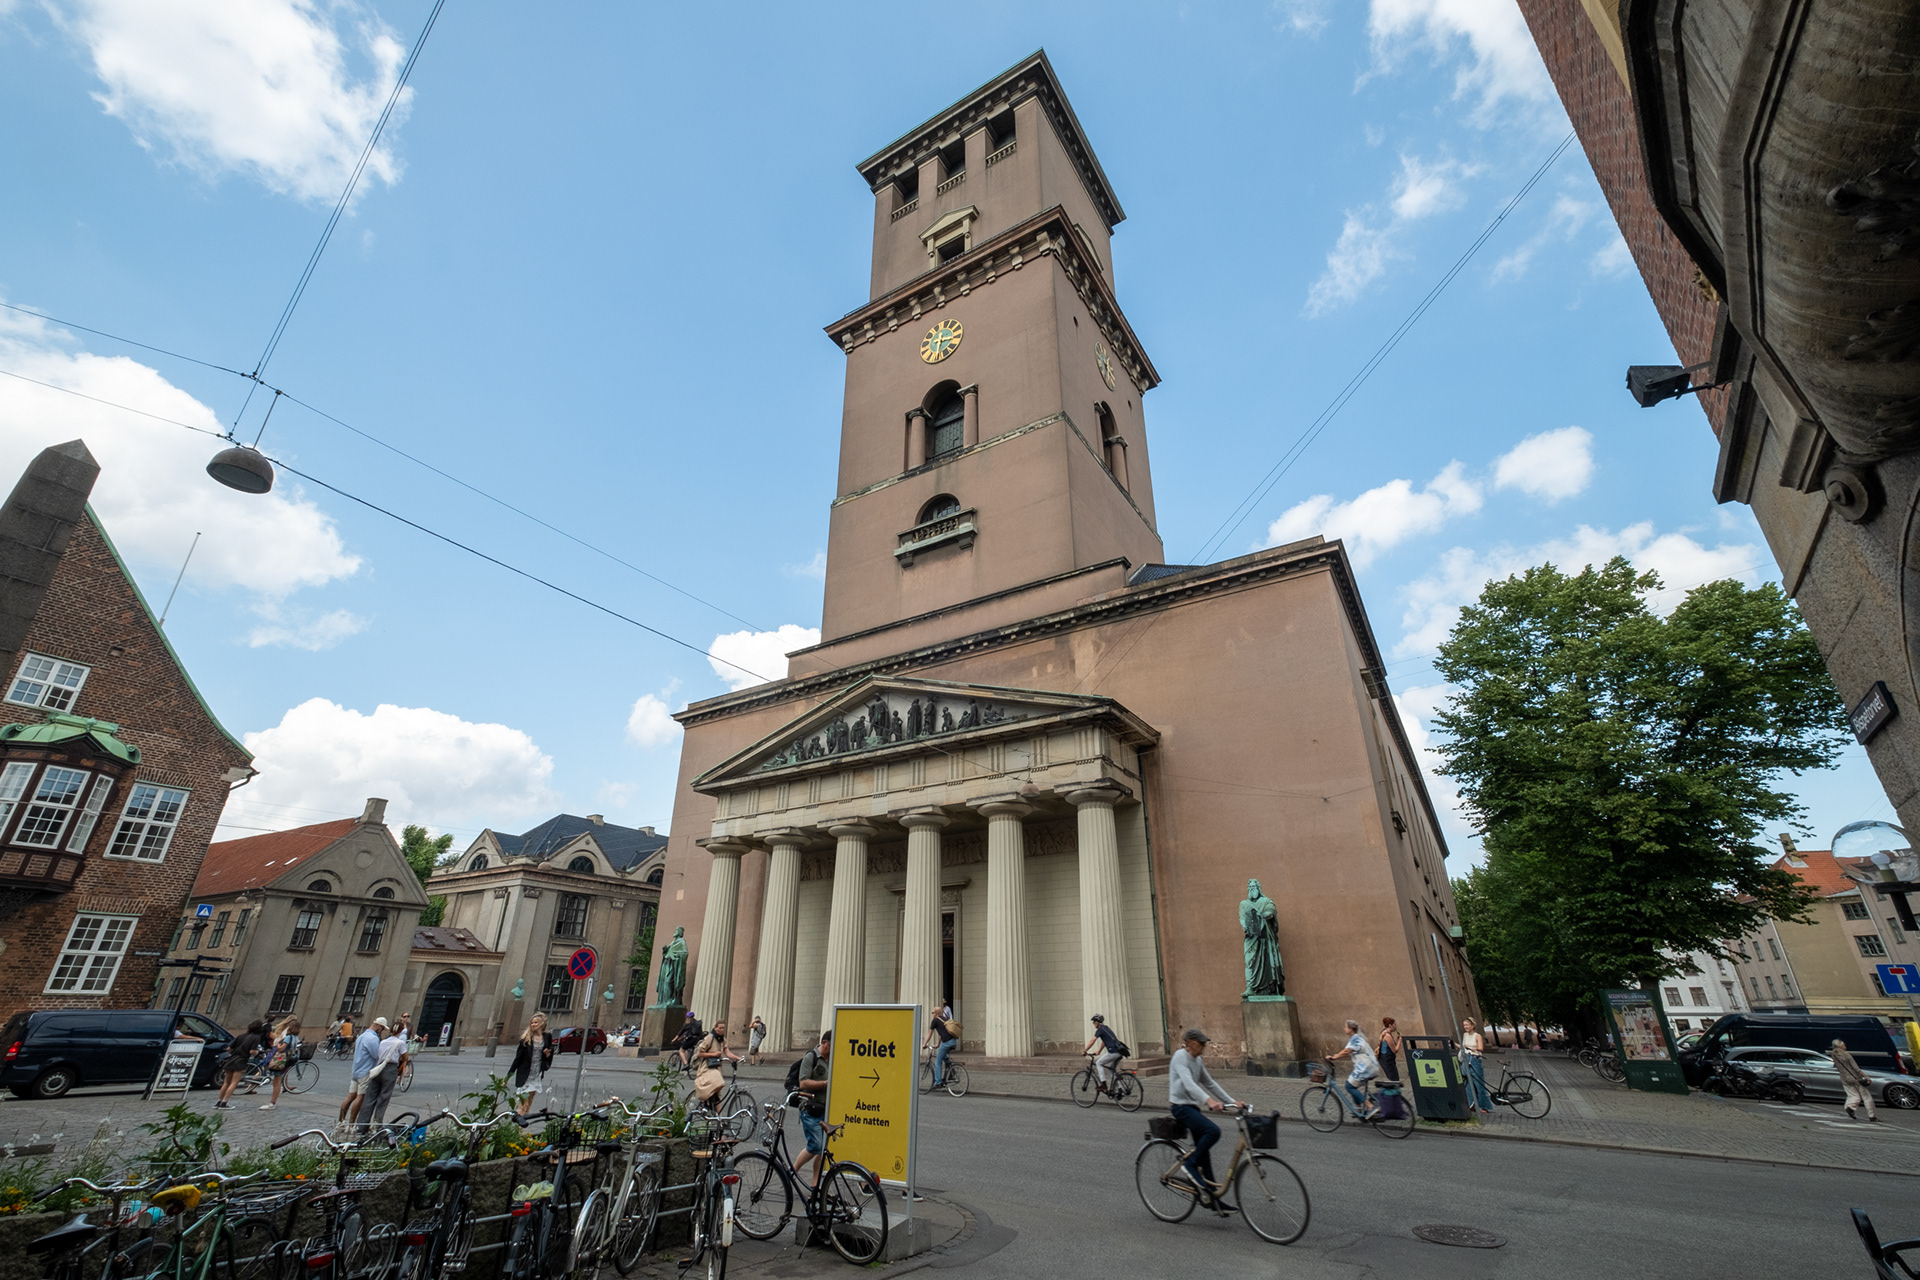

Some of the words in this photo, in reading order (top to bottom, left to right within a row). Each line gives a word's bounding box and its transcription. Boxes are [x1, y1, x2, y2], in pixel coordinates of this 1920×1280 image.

[1852, 692, 1884, 734] Bispetorvet
[849, 1038, 896, 1058] Toilet
[855, 1099, 880, 1112] Åbent
[844, 1114, 862, 1124] hele
[863, 1117, 890, 1127] natten
